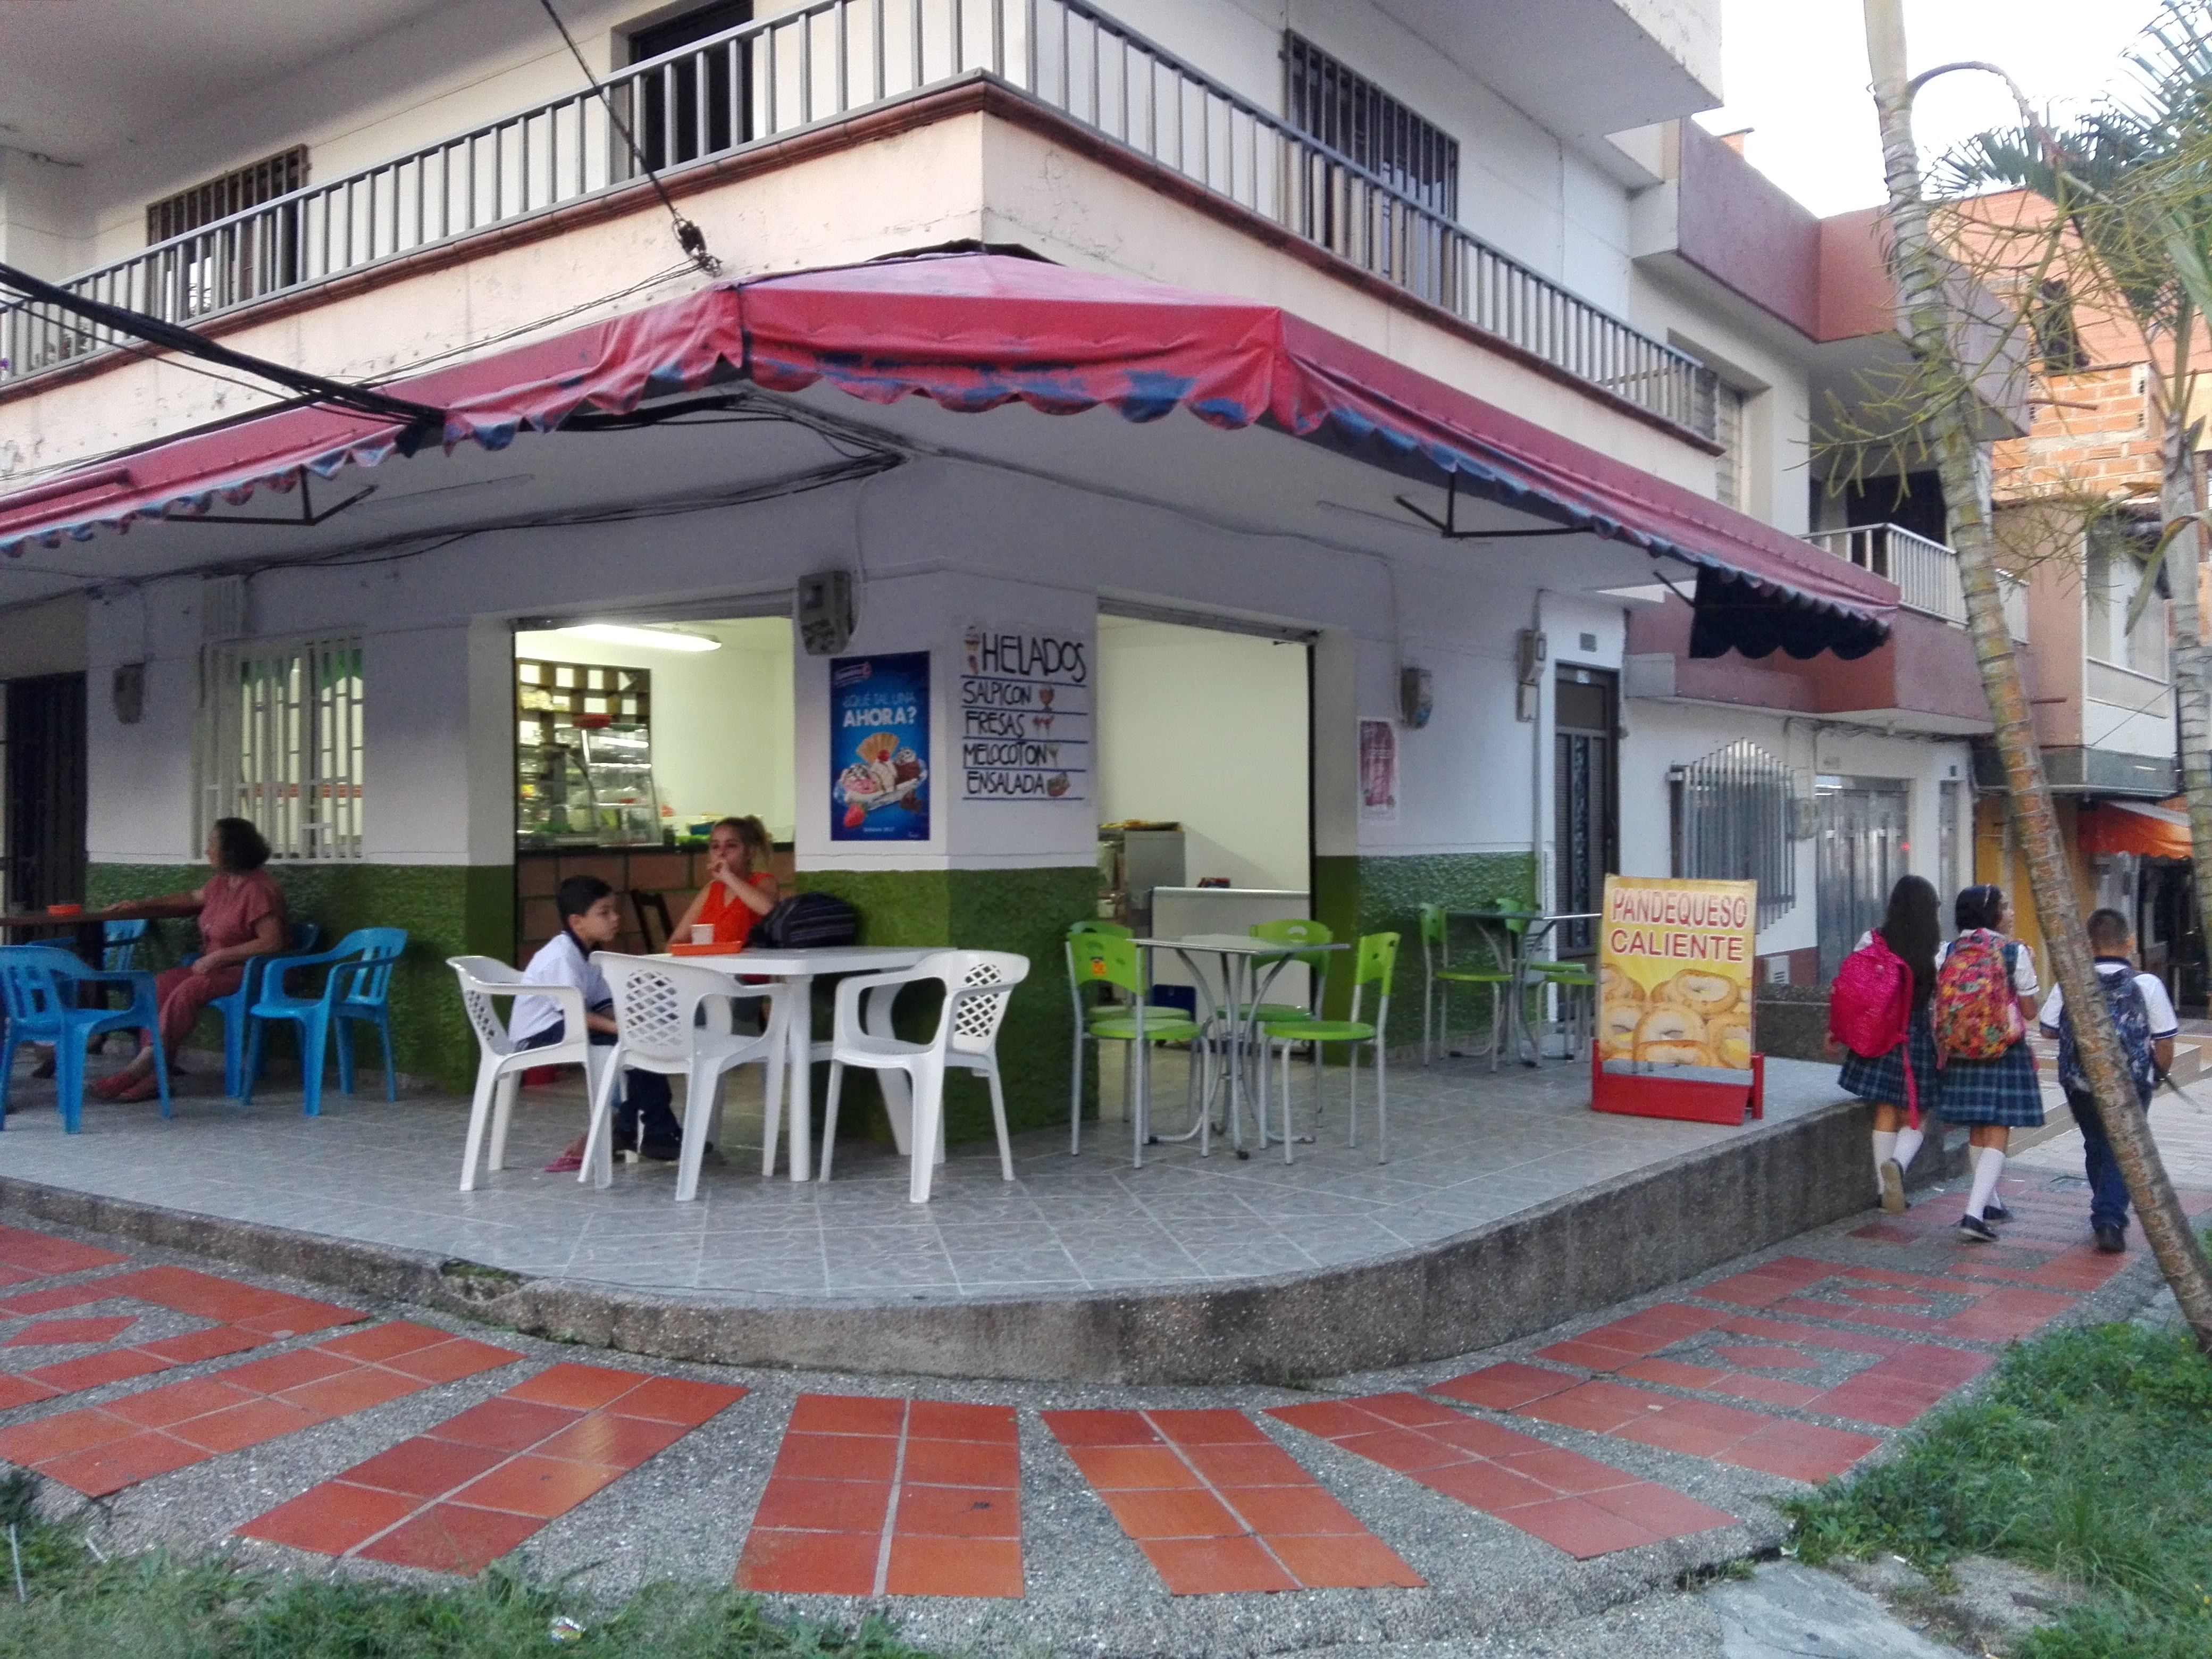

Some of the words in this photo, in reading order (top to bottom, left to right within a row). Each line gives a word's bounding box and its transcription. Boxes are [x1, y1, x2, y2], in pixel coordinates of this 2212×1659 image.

[982, 632, 1086, 683] HELADOS
[963, 681, 1032, 705] SALPICON
[842, 706, 917, 727] AHORA?
[966, 710, 1025, 738] FRESAS
[967, 771, 1045, 794] ENSALADA
[1611, 888, 1748, 928] PANDEQUESO
[1611, 929, 1744, 962] CALIENTE
